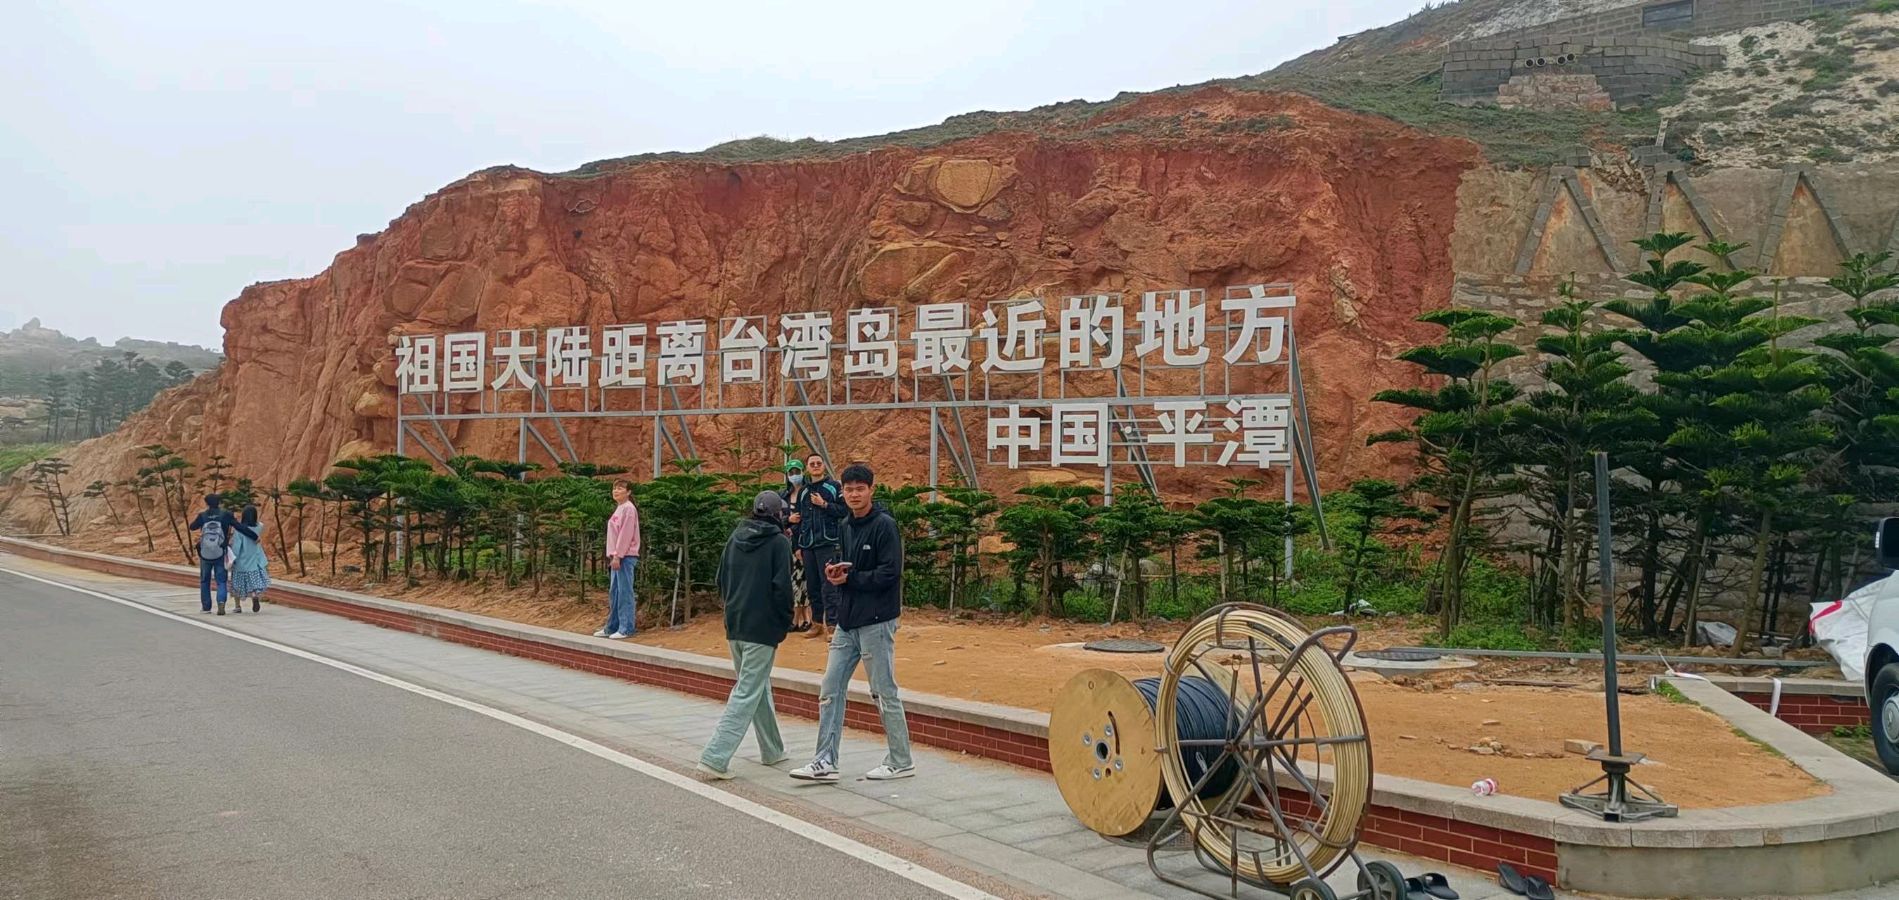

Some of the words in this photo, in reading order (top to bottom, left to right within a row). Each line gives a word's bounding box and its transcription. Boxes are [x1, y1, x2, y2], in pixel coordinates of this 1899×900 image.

[395, 284, 1297, 394] 祖国大陆距离台湾岛最近的地方
